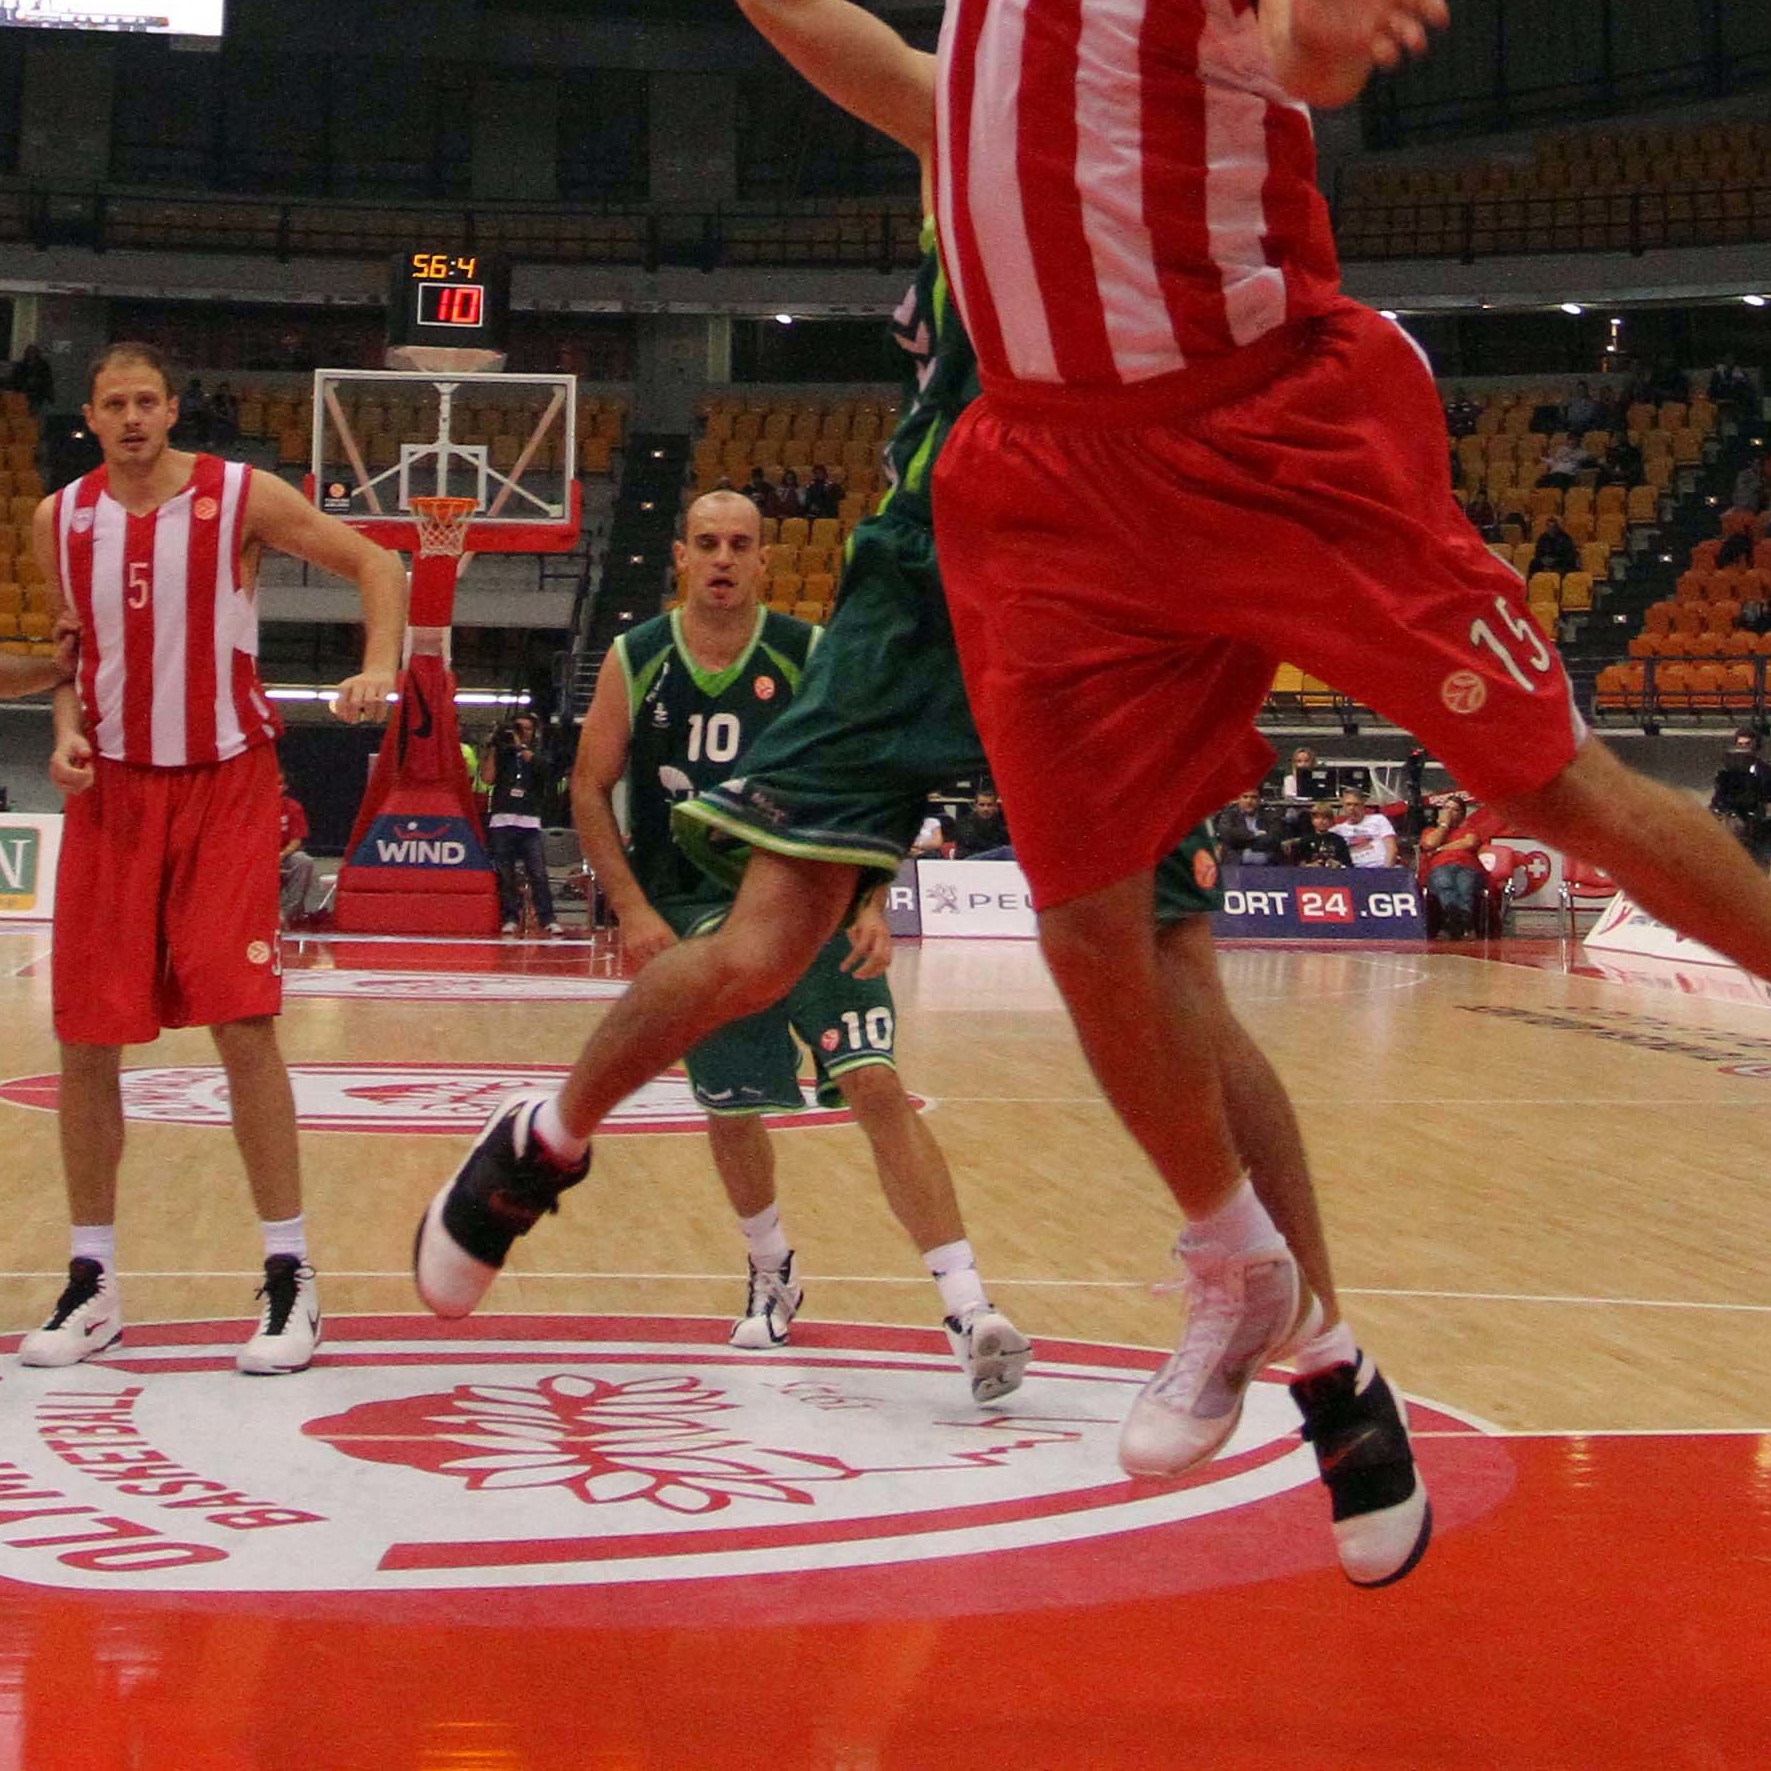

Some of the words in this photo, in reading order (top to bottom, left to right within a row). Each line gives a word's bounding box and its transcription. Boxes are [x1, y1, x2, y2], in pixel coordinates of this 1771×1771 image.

[412, 252, 476, 279] 56:4
[437, 287, 480, 325] 10
[128, 561, 149, 610] 5
[1469, 595, 1550, 692] 15
[687, 712, 740, 763] 10
[376, 838, 467, 868] WIND
[1224, 890, 1290, 918] ORT
[1302, 892, 1350, 918] 24
[1360, 892, 1419, 918] .GR
[840, 1005, 894, 1051] 10
[36, 1382, 329, 1531] BASKETBALL
